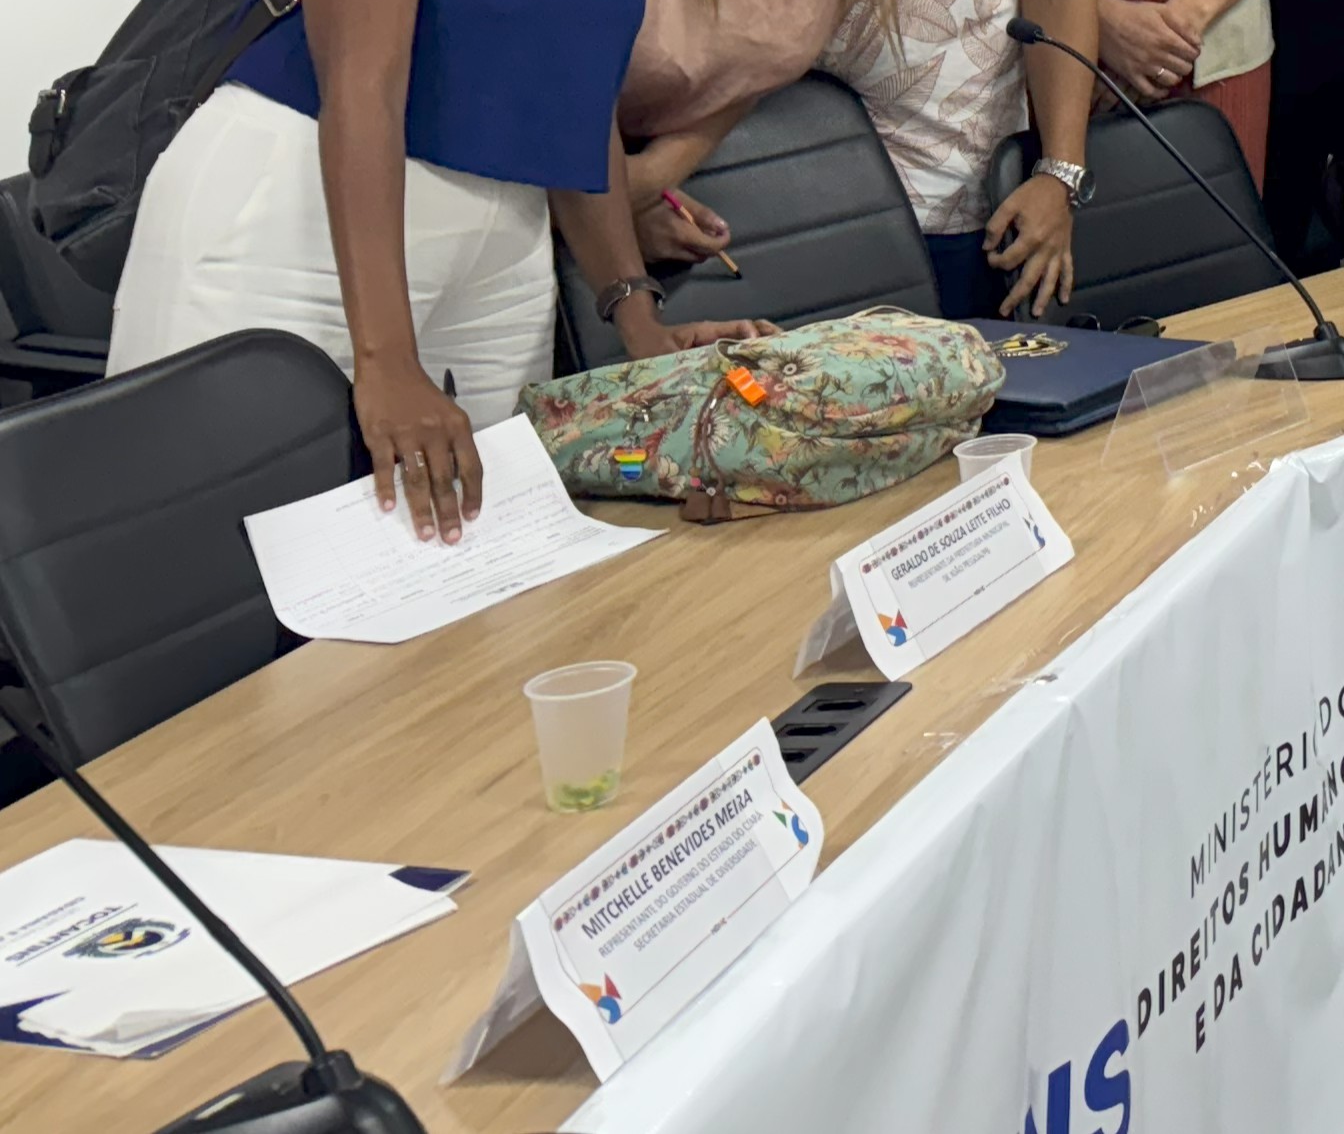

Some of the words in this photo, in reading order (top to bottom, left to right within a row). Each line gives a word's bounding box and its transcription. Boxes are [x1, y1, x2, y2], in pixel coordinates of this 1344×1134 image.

[890, 550, 929, 581] GERALDO
[927, 541, 941, 559] DE
[938, 527, 968, 552] SOUZA
[966, 513, 989, 537] LEITE
[984, 497, 1011, 526] FILHO
[580, 871, 654, 940] MITCHELLE
[651, 820, 716, 884] BENEVIDES
[715, 787, 754, 834] MEIRA
[1190, 721, 1318, 899] MINISTÉRI
[598, 900, 660, 958] REPRESENTANTE
[656, 888, 669, 905] DO
[666, 866, 701, 901] GOVERNO
[698, 859, 711, 876] DO
[707, 834, 734, 865] ESTADO
[731, 825, 746, 843] DO
[634, 907, 677, 952] SECRETARIA
[674, 879, 709, 916] ESTADUAL
[708, 873, 720, 889] DE
[1137, 859, 1250, 1039] DIREITOS
[1195, 1000, 1206, 1054] E
[1213, 953, 1244, 1022] DA
